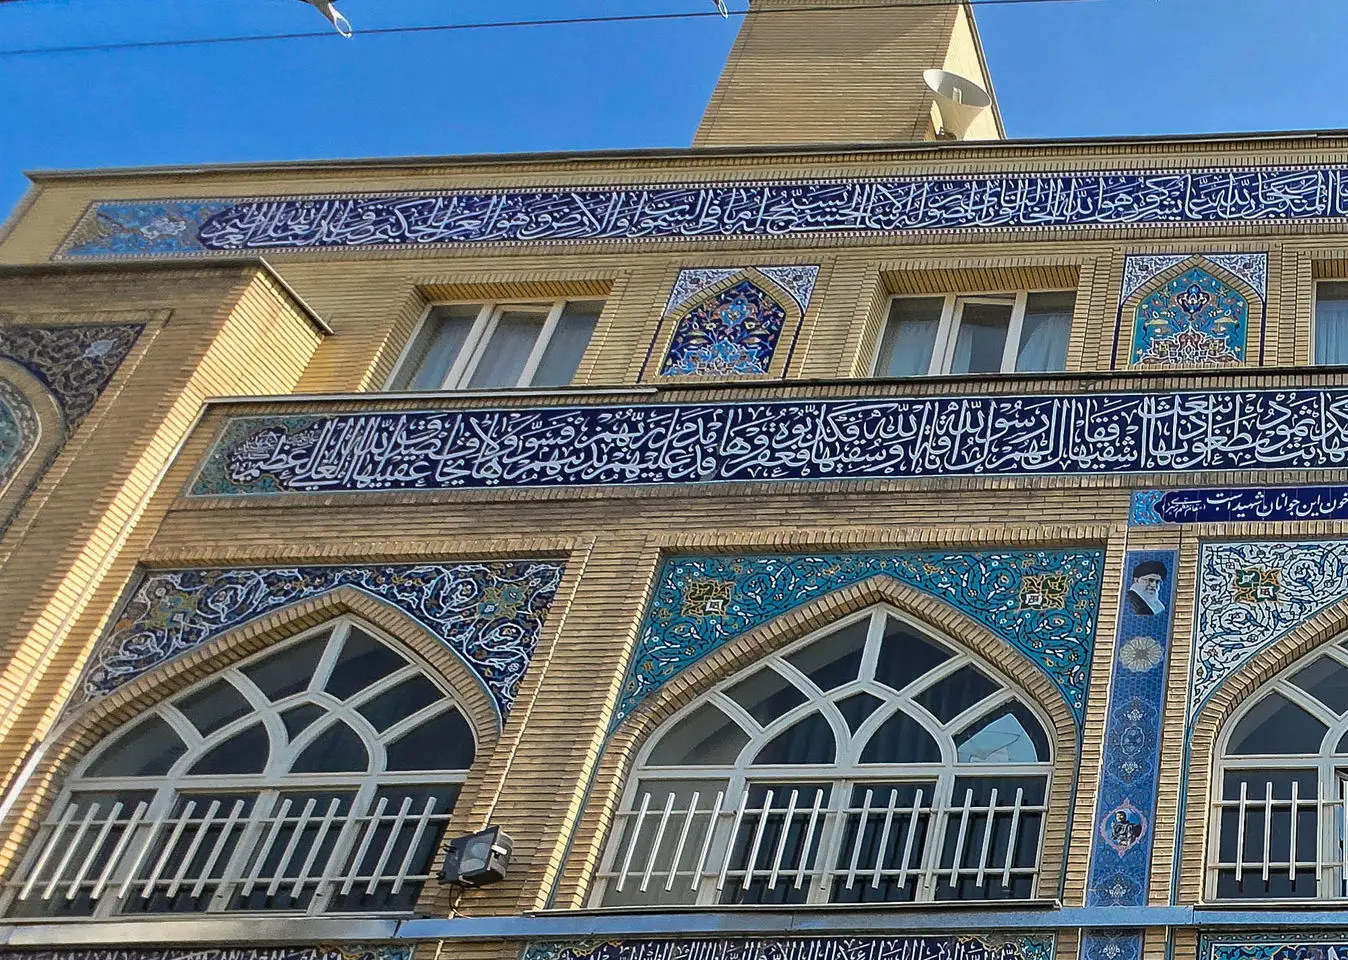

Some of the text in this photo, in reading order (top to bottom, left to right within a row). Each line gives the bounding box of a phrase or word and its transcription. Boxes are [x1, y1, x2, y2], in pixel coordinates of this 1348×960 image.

[1206, 492, 1243, 511] است
[1232, 491, 1264, 517] شهید
[1256, 492, 1300, 517] جوانان
[1295, 494, 1320, 517] این
